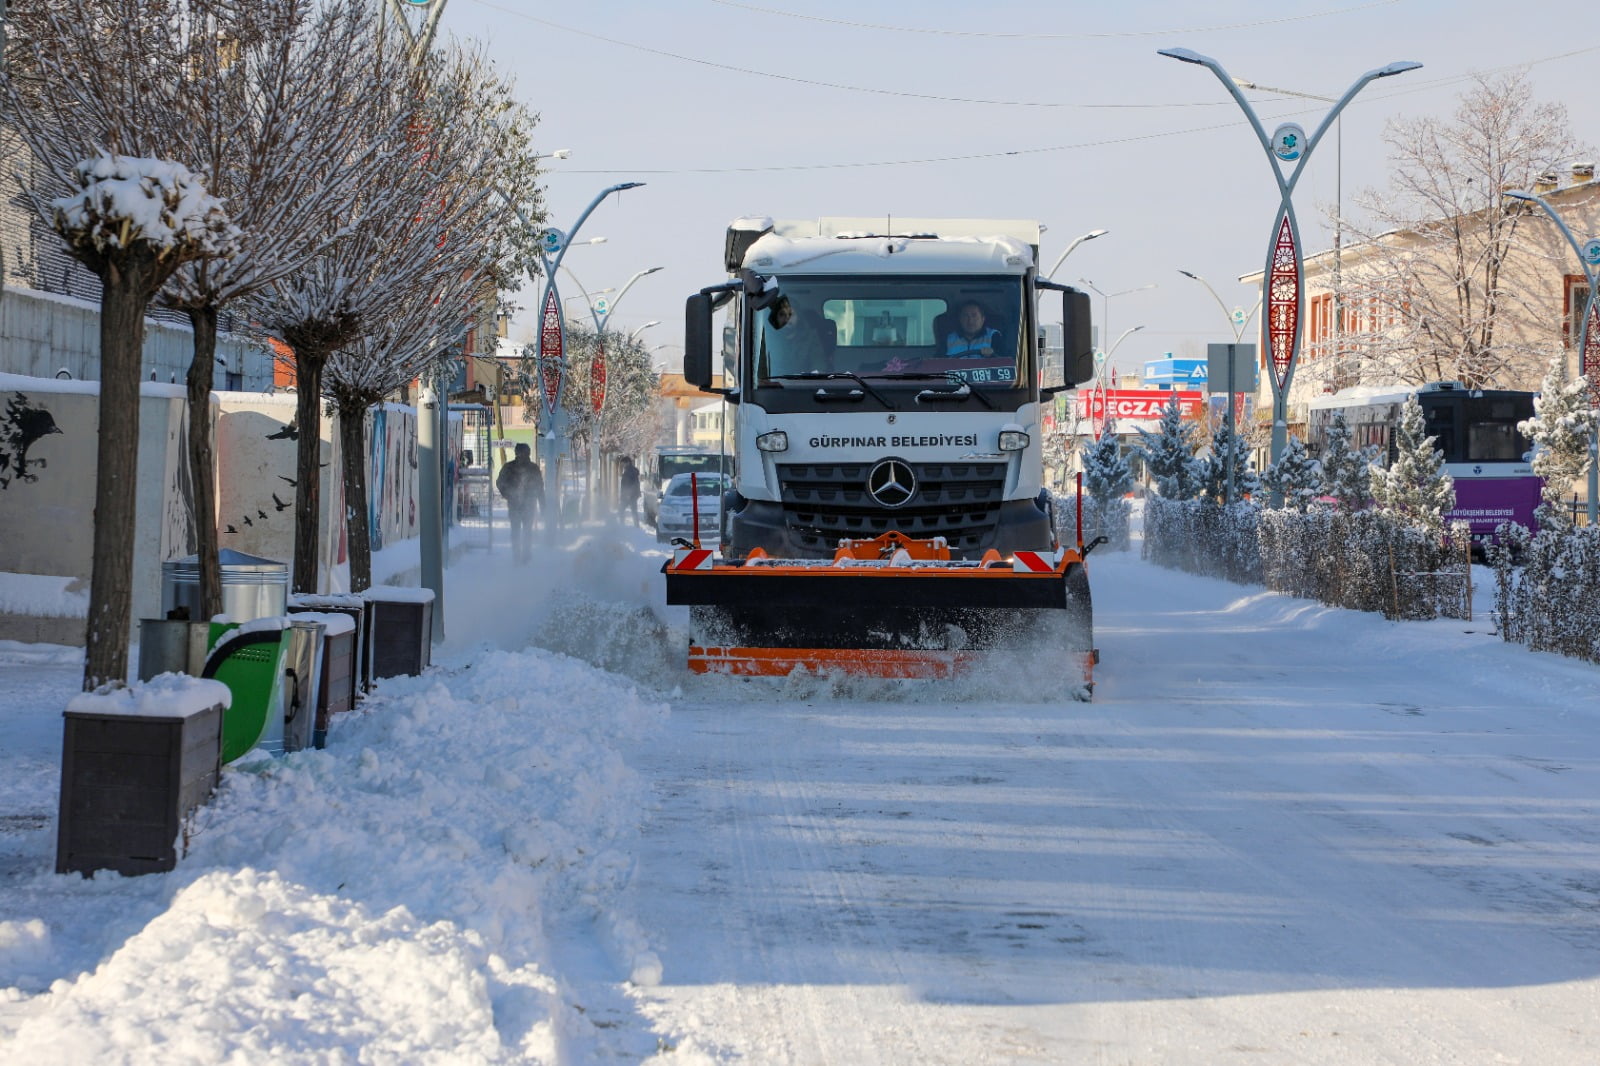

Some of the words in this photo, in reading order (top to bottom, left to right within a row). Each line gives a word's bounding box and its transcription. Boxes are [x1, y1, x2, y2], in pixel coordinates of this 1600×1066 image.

[997, 369, 1011, 380] 65
[809, 435, 886, 448] GÜRPINAR
[891, 433, 977, 447] BELEDİYESİ
